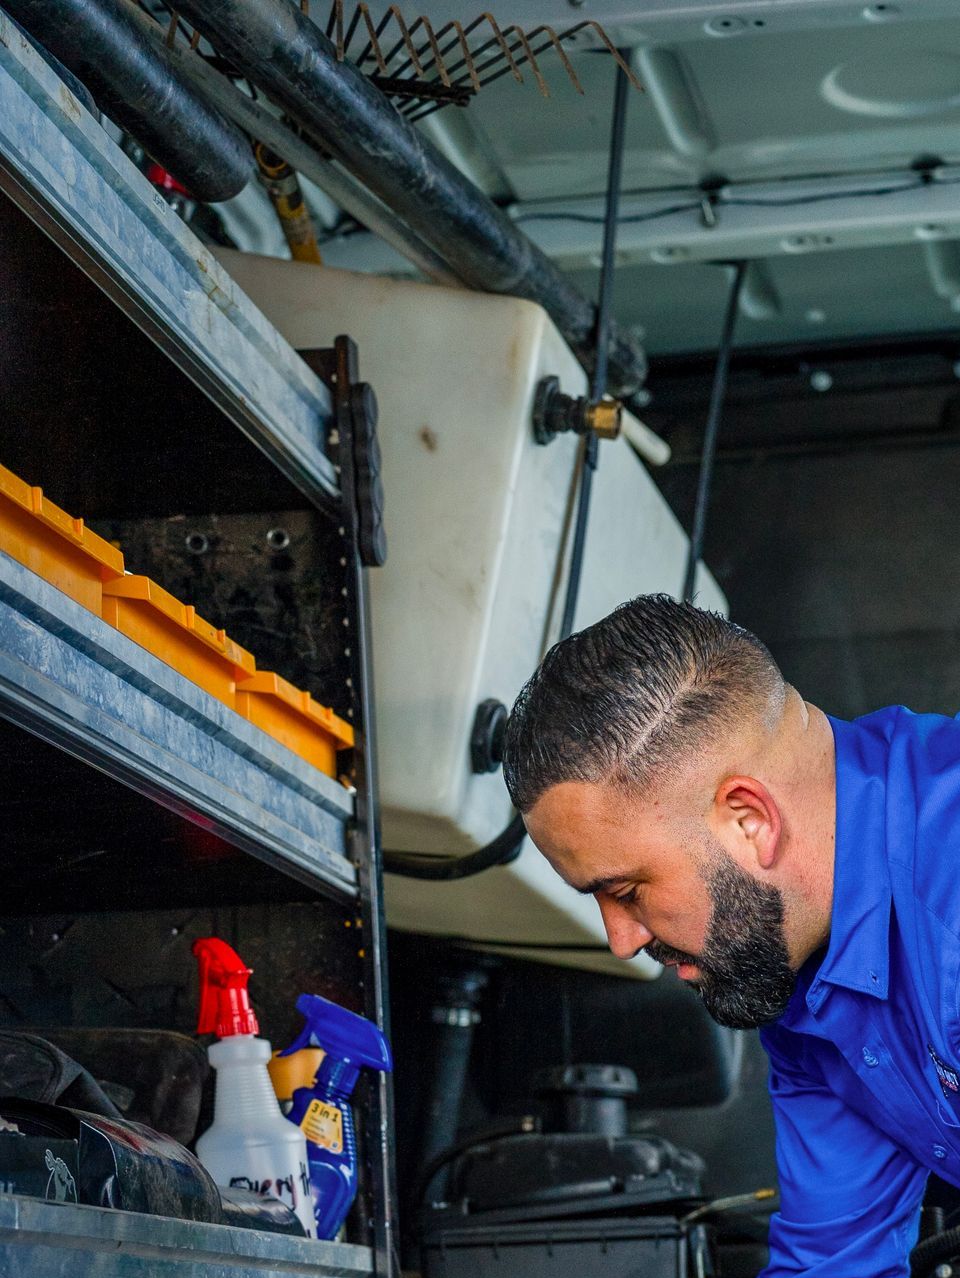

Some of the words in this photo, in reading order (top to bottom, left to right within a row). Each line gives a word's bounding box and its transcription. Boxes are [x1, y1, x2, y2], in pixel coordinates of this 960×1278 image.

[311, 1103, 319, 1114] 3
[319, 1108, 330, 1120] in
[332, 1113, 339, 1123] 1
